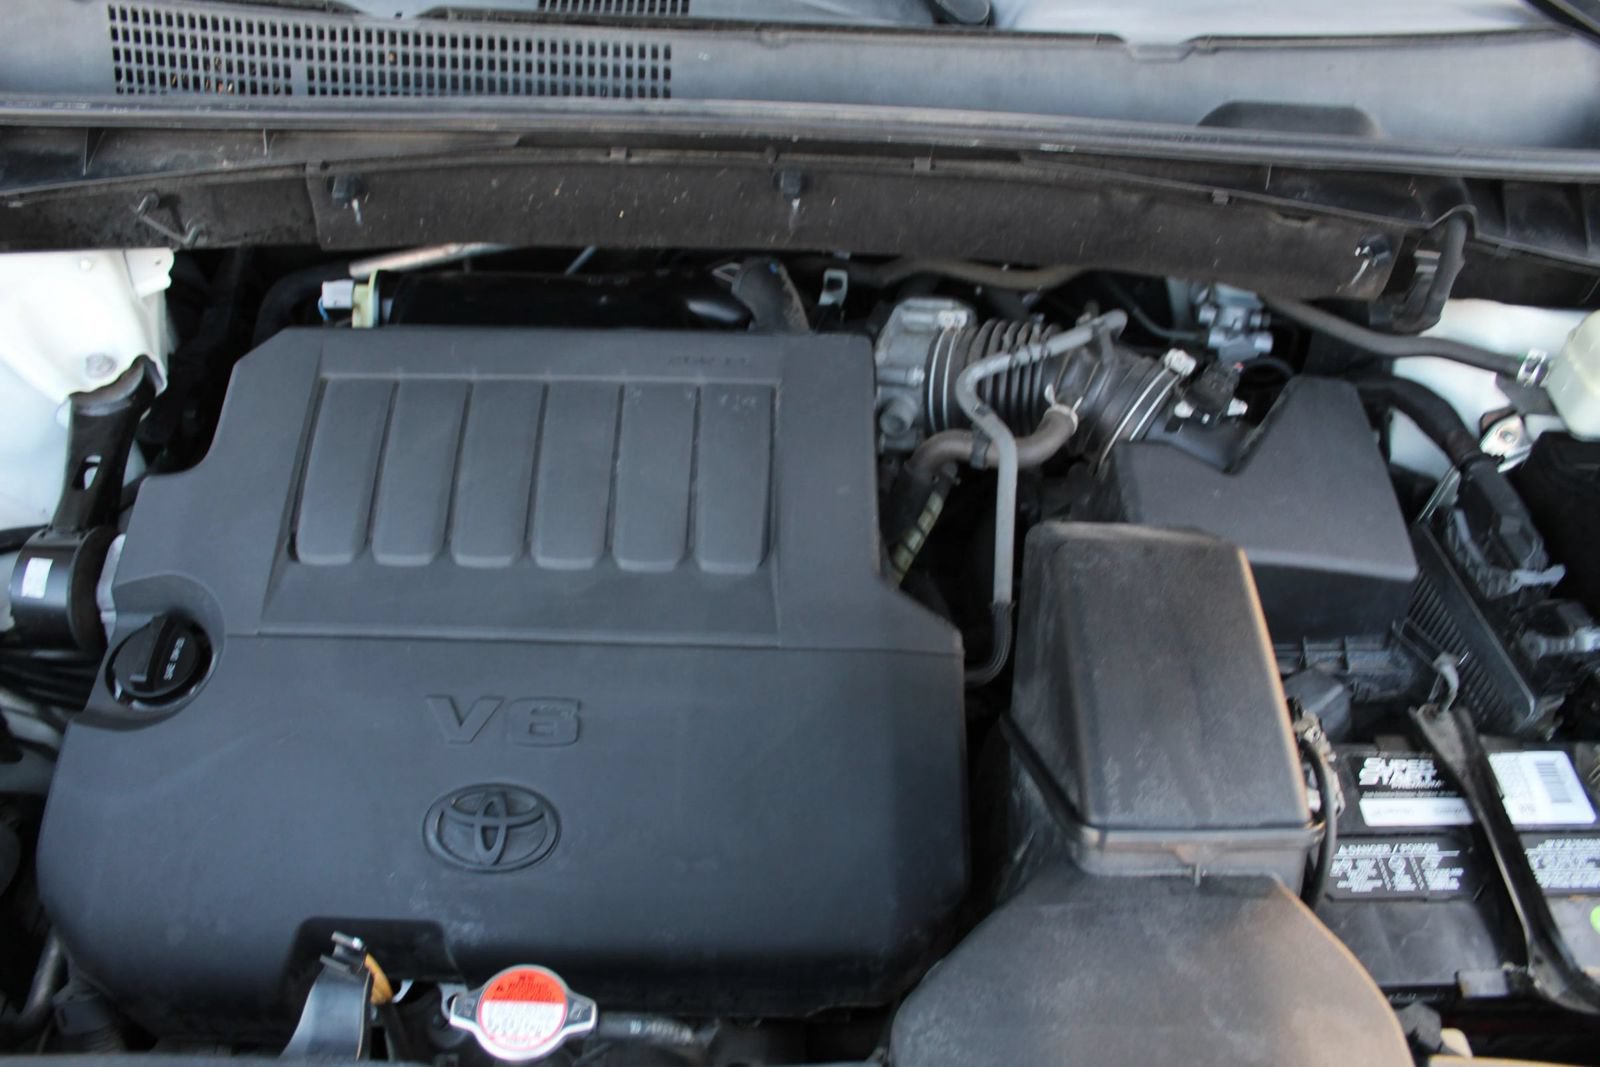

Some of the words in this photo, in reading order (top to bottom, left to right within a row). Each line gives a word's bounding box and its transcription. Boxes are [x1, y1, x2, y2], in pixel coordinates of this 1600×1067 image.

[426, 695, 582, 747] V6
[1348, 844, 1392, 856] DANGER
[1400, 843, 1440, 855] POISON
